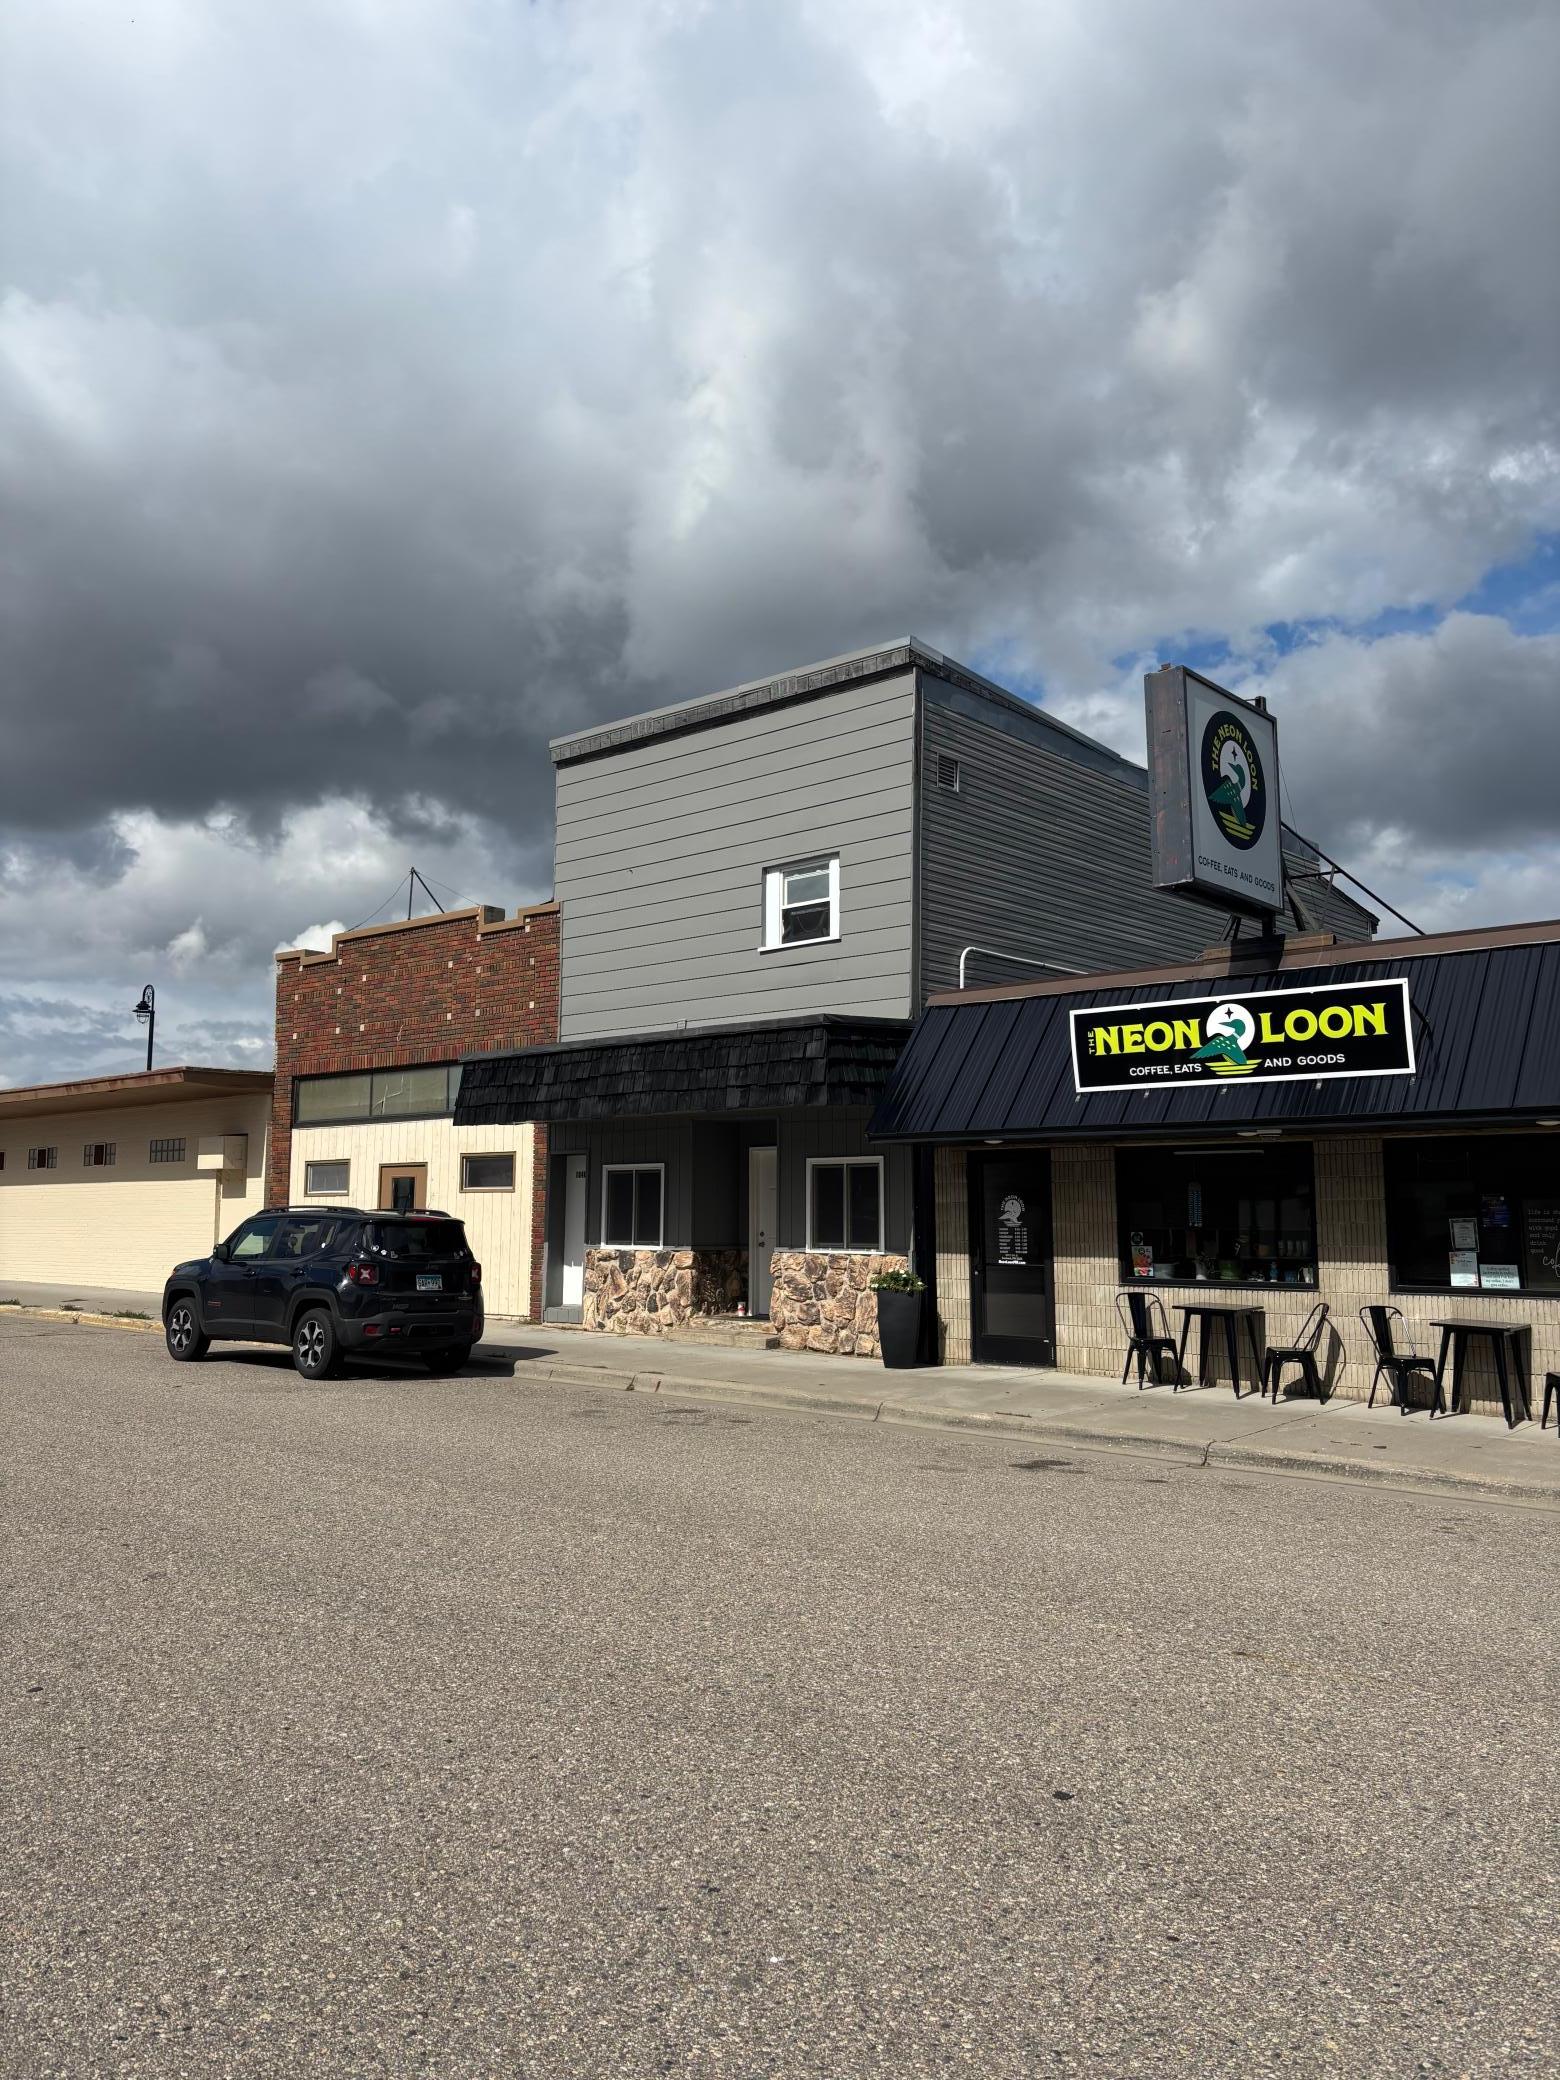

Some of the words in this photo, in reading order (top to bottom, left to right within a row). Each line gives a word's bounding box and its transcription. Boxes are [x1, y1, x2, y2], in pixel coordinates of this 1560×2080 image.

[1211, 738, 1222, 770] THE
[1217, 724, 1243, 743] NEON
[1242, 738, 1258, 791] LOON
[1223, 864, 1239, 879] EATS
[1239, 871, 1253, 884] AND
[1254, 876, 1276, 892] GOODS
[1095, 1018, 1202, 1056] NEON
[1259, 1002, 1390, 1044] LOON
[1129, 1064, 1173, 1077] COFFEE,
[1174, 1063, 1202, 1075] EATS
[1264, 1057, 1292, 1068] AND
[1297, 1054, 1346, 1066] GOODS
